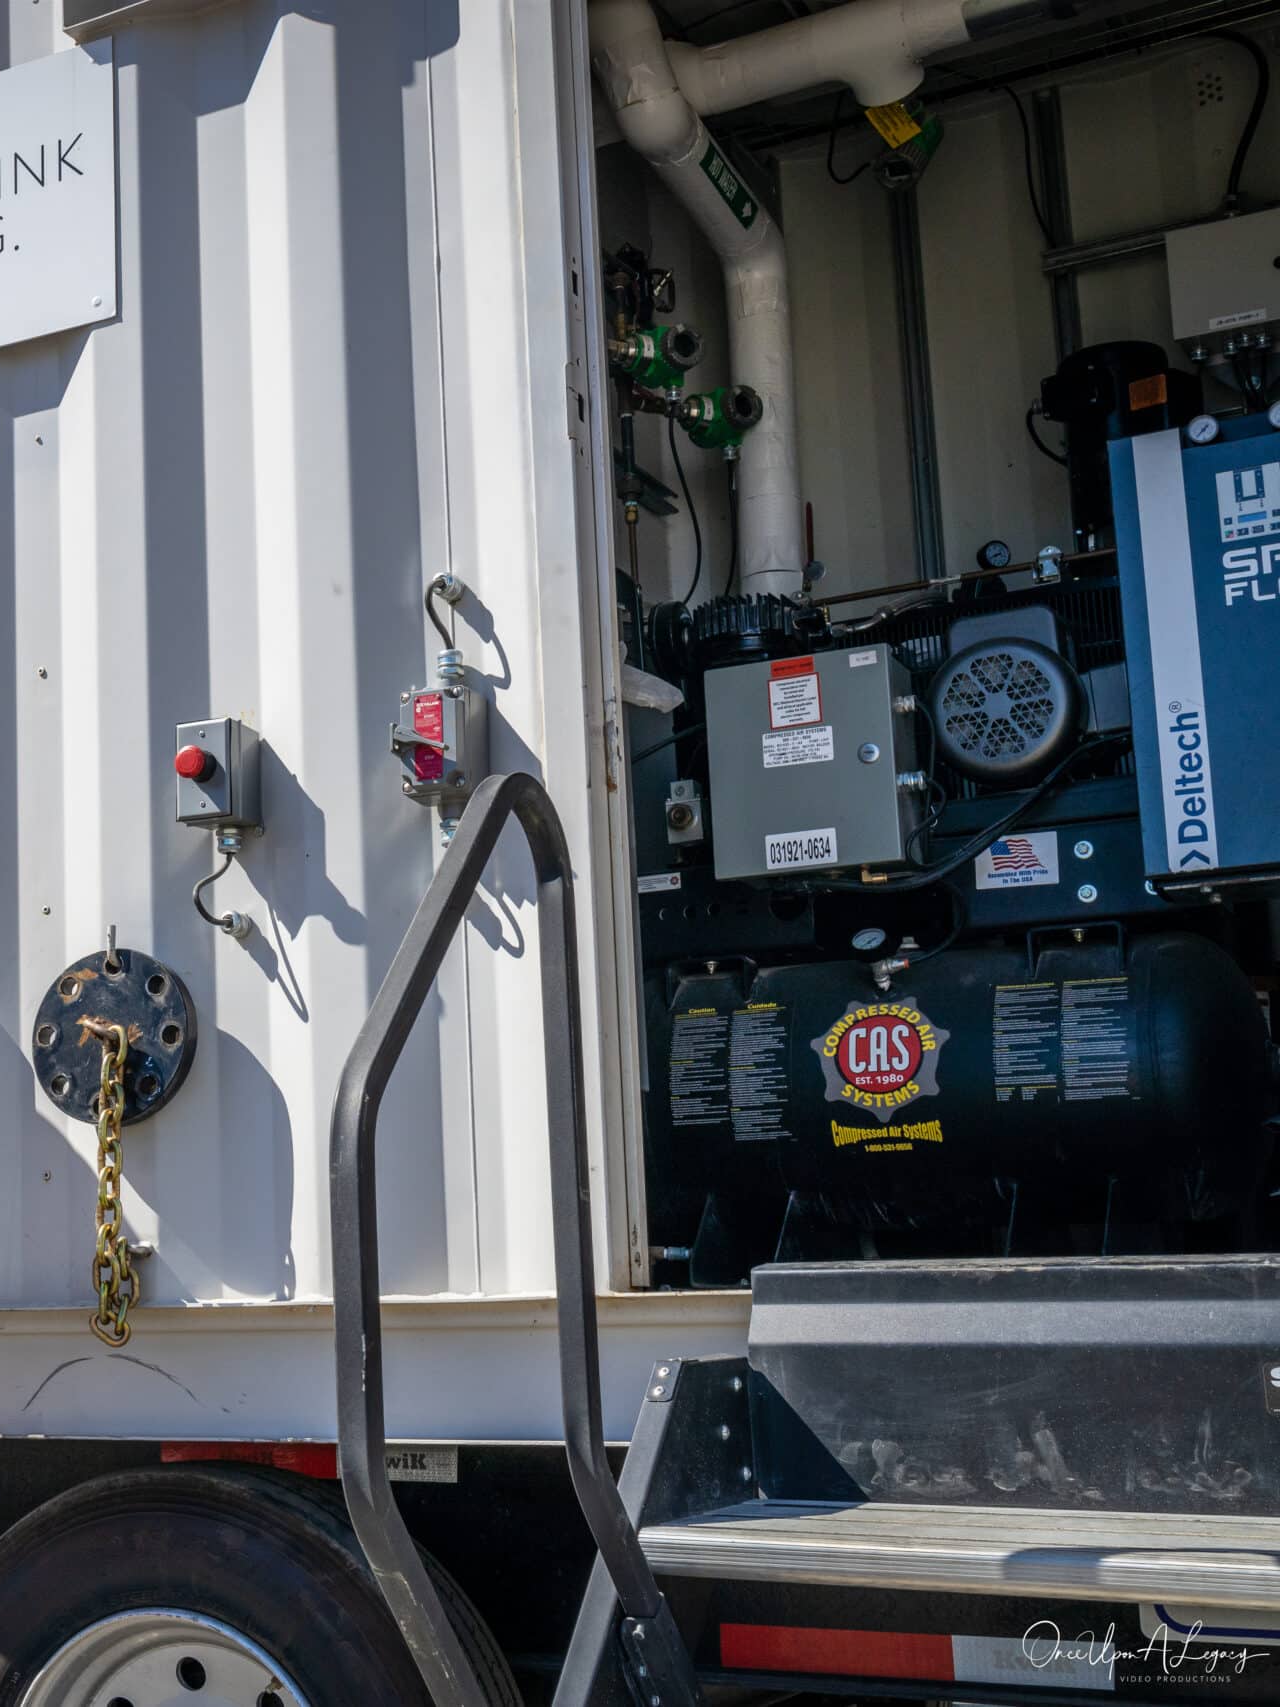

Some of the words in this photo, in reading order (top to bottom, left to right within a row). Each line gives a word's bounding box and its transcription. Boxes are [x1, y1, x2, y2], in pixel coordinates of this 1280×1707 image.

[1224, 578, 1280, 607] FL
[770, 836, 832, 864] 031921-0634
[823, 1003, 921, 1057] COMPRESSED
[915, 1023, 936, 1051] AIR
[848, 1024, 910, 1073] CAS
[855, 1076, 873, 1085] EST.
[875, 1073, 904, 1084] 1980
[841, 1080, 920, 1107] SYSTEMS
[831, 1119, 888, 1147] Compressed
[888, 1126, 902, 1137] Air
[902, 1119, 944, 1143] Systems
[384, 1452, 427, 1471] wiK
